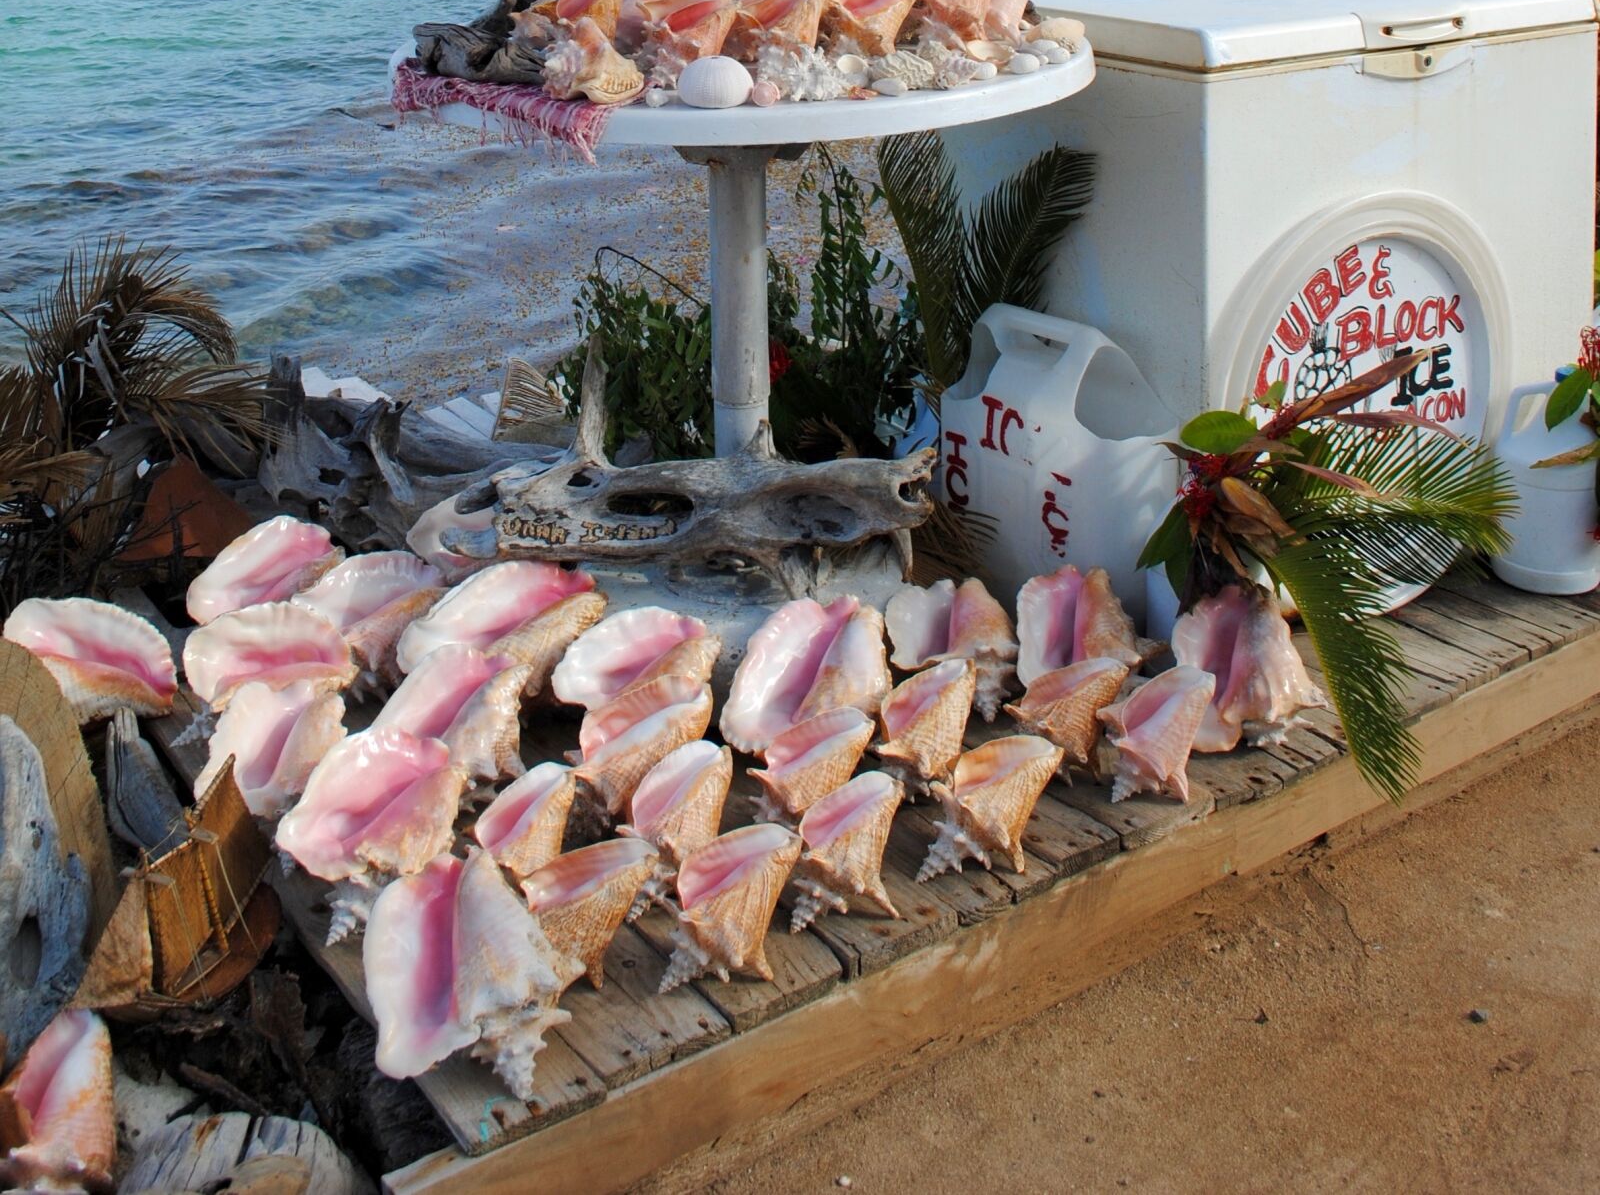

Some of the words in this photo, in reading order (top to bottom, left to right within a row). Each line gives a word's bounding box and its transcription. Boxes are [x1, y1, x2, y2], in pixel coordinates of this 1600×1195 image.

[1254, 244, 1367, 400] CUBE
[1368, 244, 1395, 300] &
[1335, 294, 1465, 362] BLOCK
[1390, 343, 1453, 407] ICE
